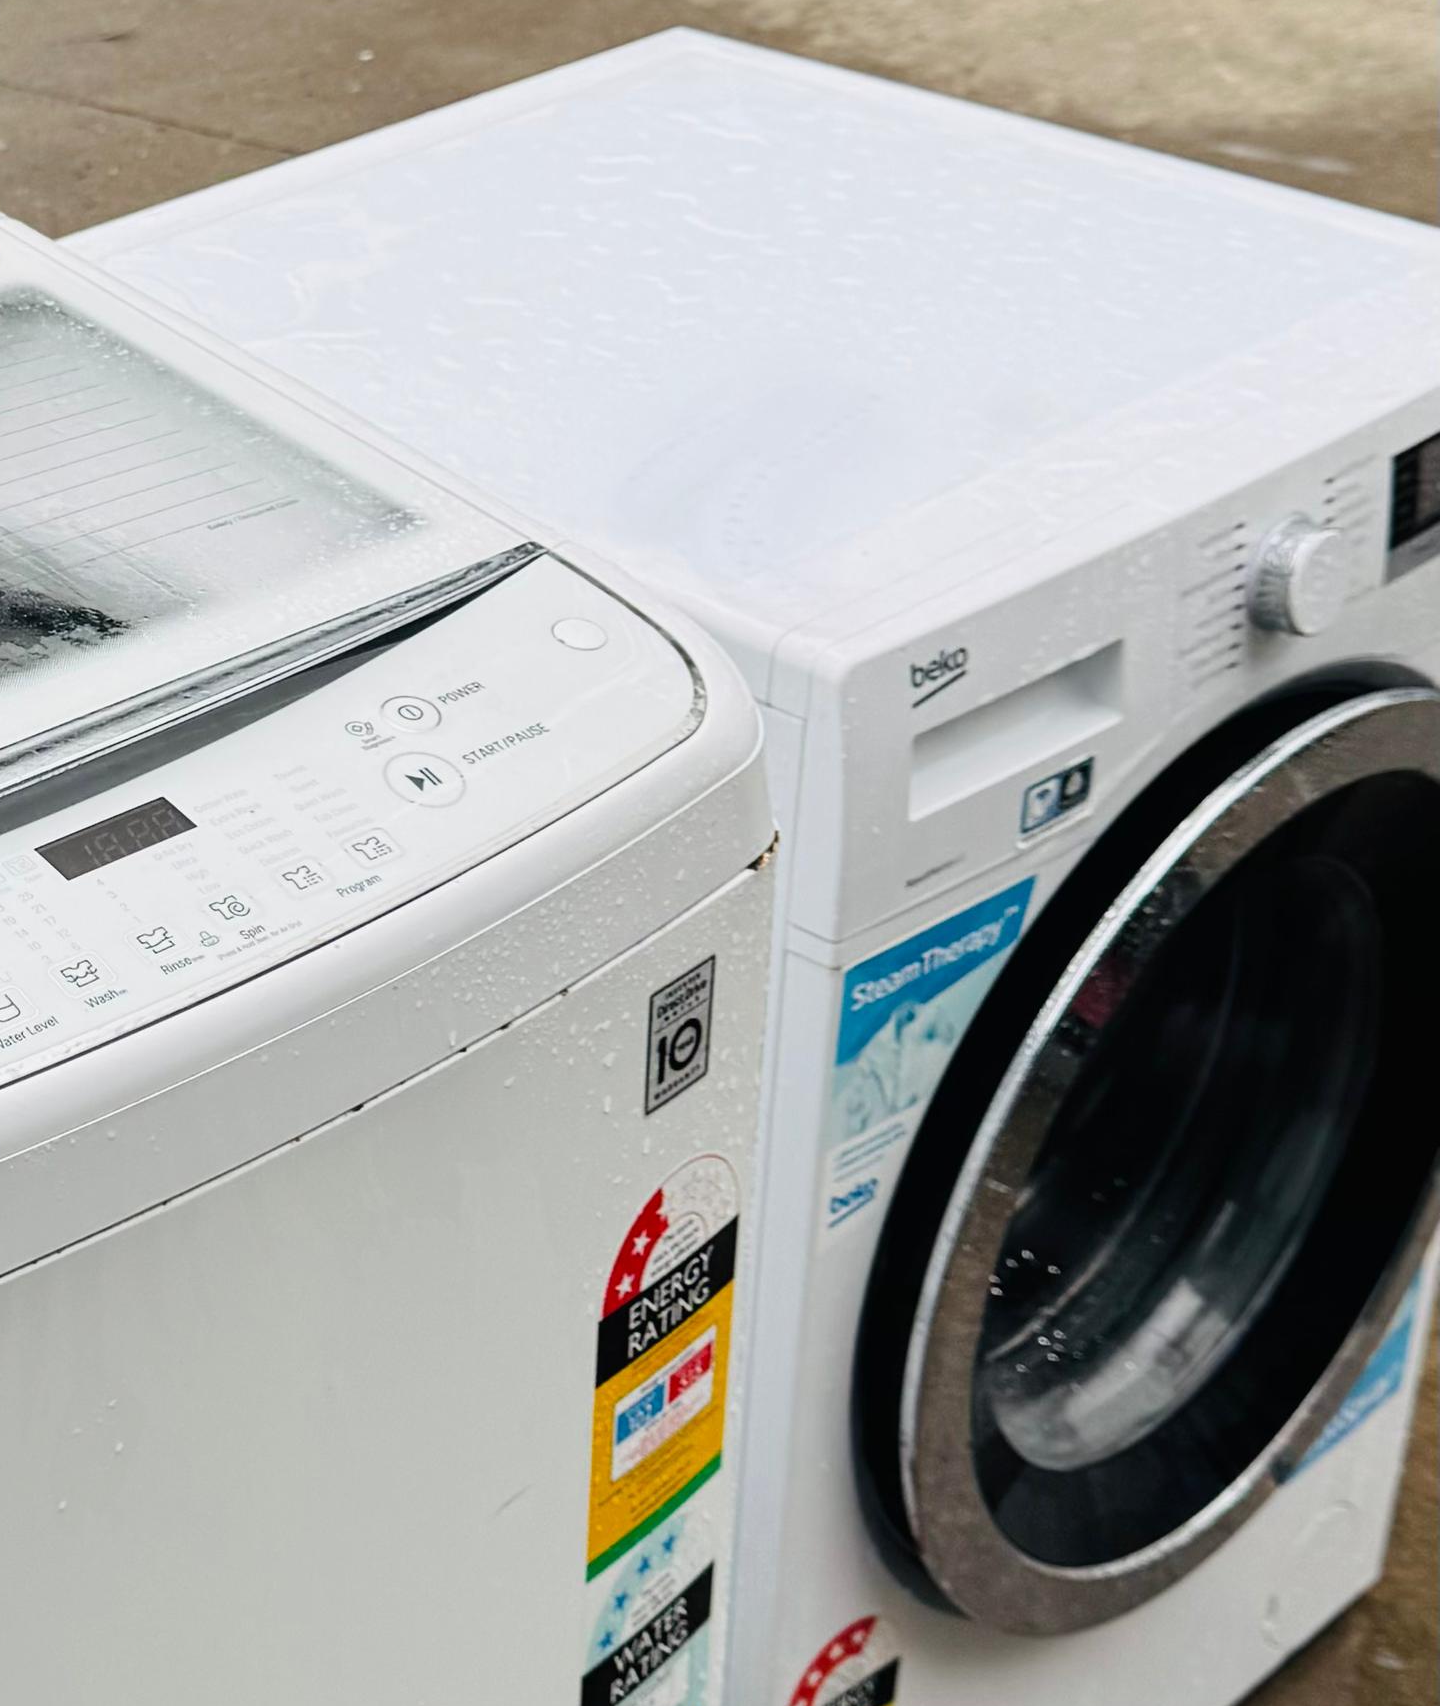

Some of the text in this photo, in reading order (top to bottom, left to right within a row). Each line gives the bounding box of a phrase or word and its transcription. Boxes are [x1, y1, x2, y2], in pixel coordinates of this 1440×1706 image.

[910, 647, 969, 689] beko
[437, 681, 486, 704] POWER
[462, 722, 550, 765] START/PAUSE
[336, 873, 382, 898] Program
[239, 923, 266, 941] Spin
[160, 957, 192, 976] Rinse
[84, 988, 120, 1009] Wash
[26, 1015, 60, 1037] Level
[657, 1018, 702, 1085] 10
[628, 1245, 714, 1330] ENERGY
[627, 1277, 710, 1359] RATING
[613, 1596, 687, 1673] WATER
[609, 1619, 689, 1706] RATING
